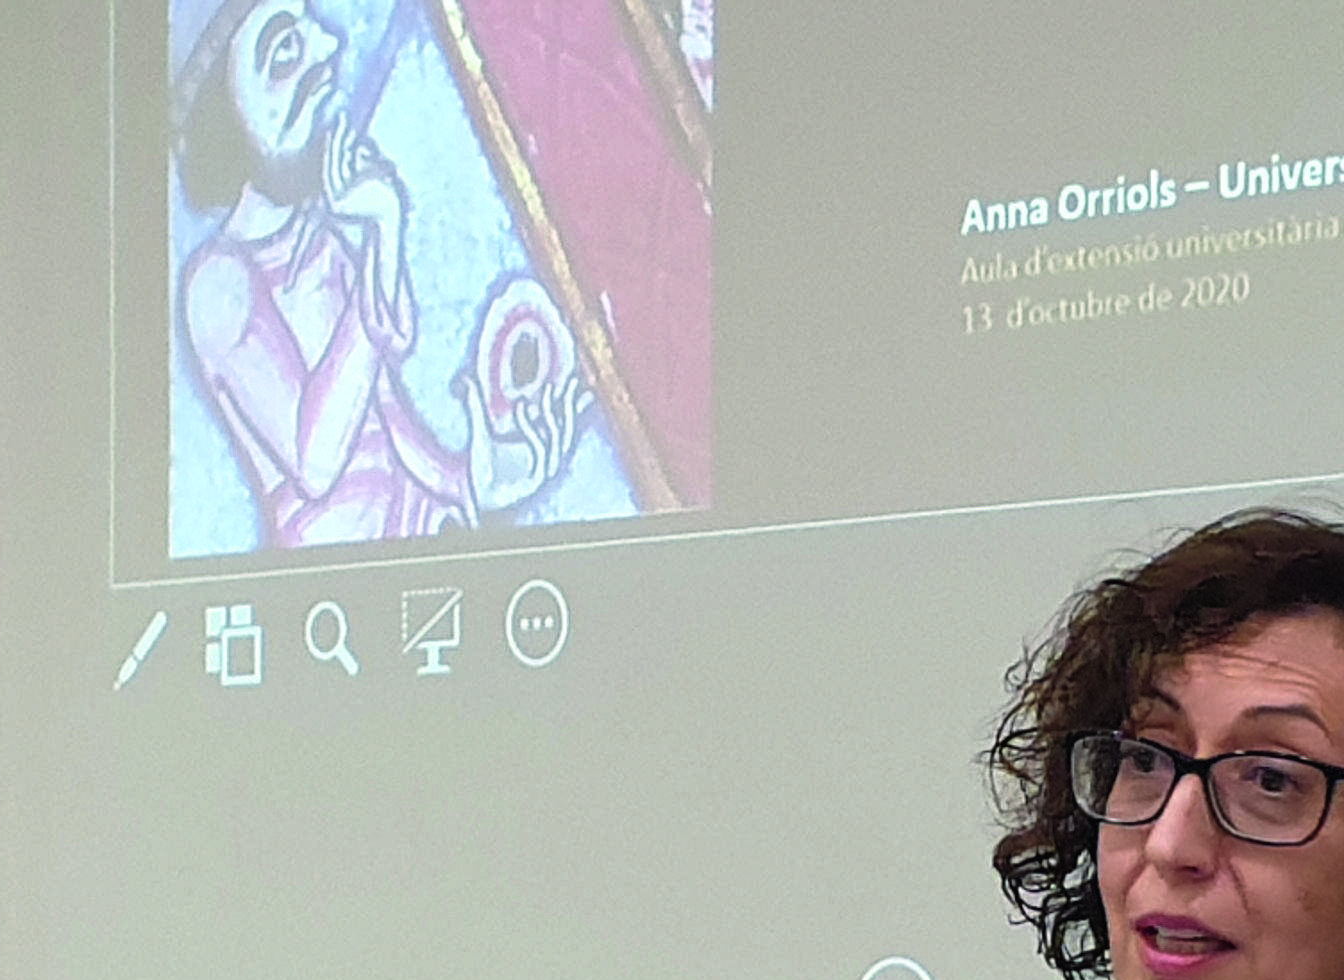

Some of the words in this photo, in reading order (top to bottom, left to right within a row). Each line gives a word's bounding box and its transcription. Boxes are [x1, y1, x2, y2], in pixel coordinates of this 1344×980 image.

[961, 199, 1049, 236] Anna
[1058, 169, 1177, 221] Orriols
[961, 252, 1018, 284] Aula
[1025, 235, 1160, 277] d'extensió
[1166, 213, 1340, 258] universitària
[963, 302, 994, 334] 13
[1006, 289, 1132, 329] d'octubre
[1138, 282, 1174, 313] de
[1181, 272, 1251, 308] 2020
